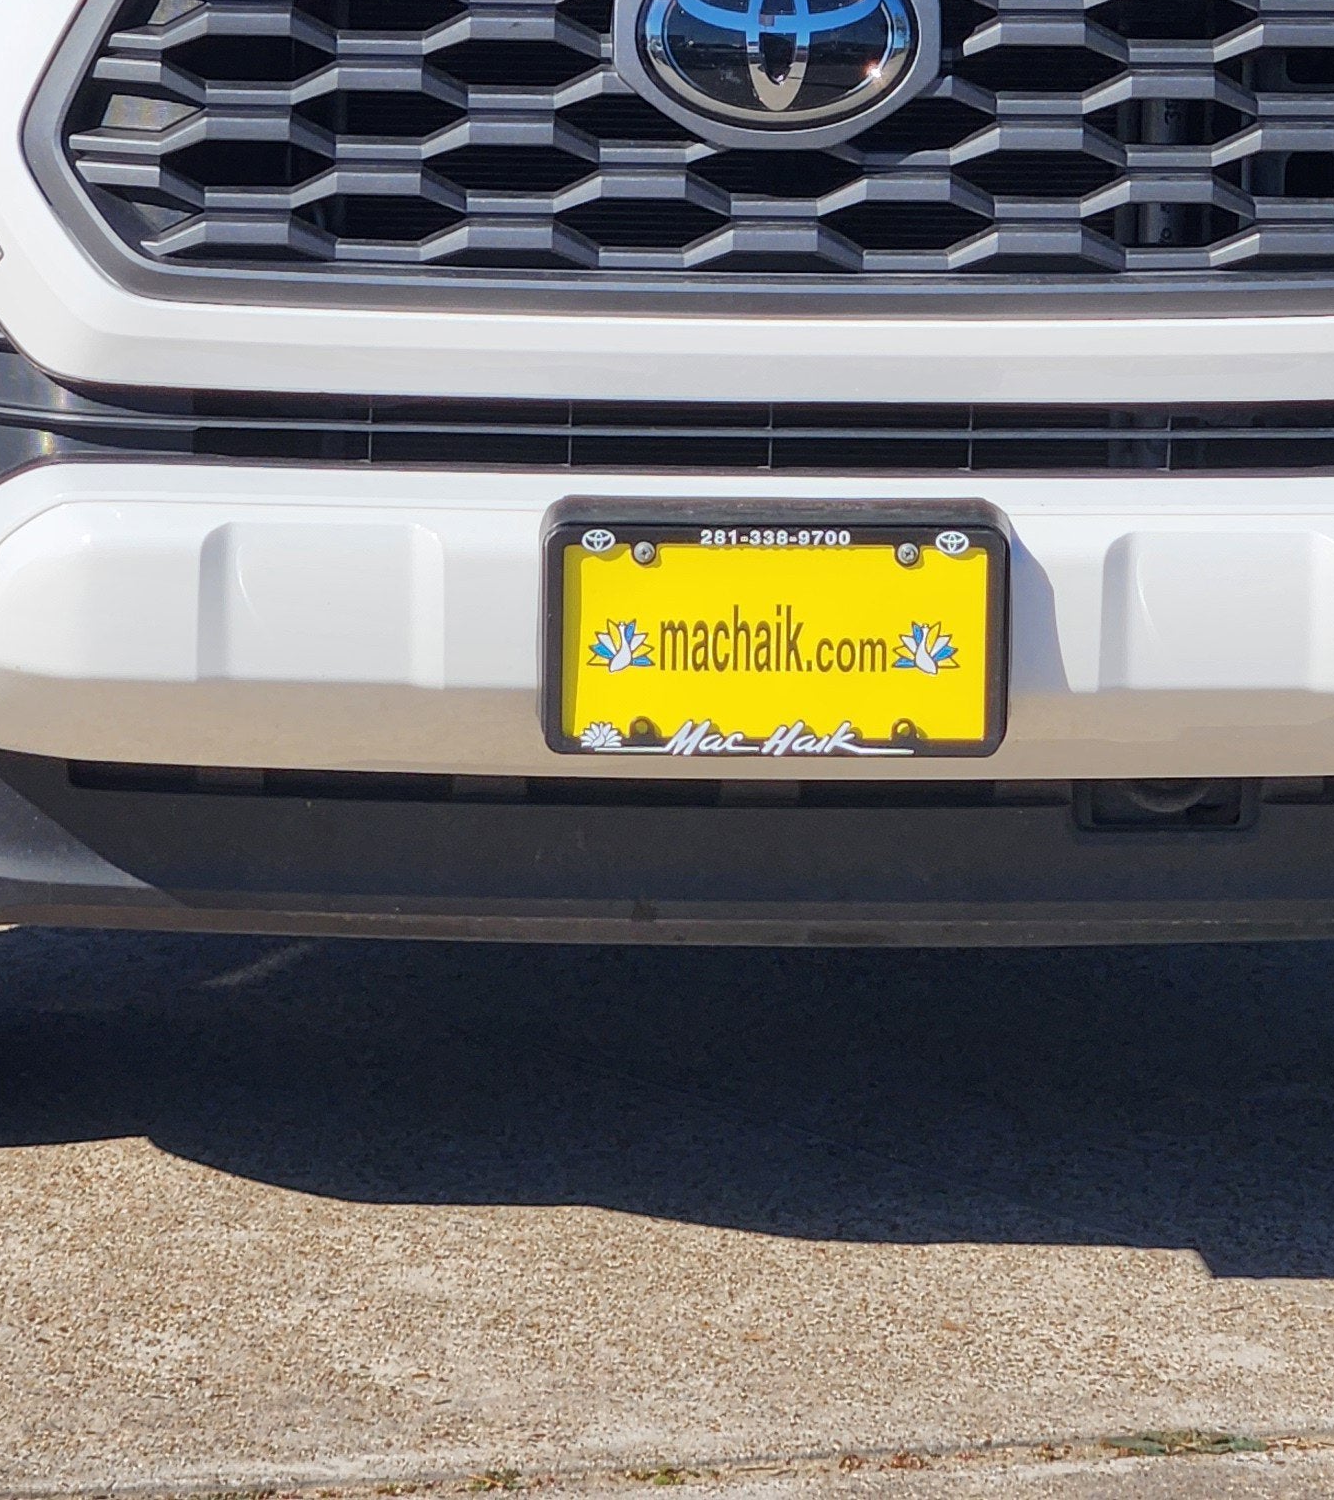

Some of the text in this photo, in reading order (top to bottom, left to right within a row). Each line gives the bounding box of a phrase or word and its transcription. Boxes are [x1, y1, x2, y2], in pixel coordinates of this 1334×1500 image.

[700, 529, 851, 547] 281-338-9700
[659, 604, 888, 673] machaik.com
[666, 719, 857, 756] Mac Haik
